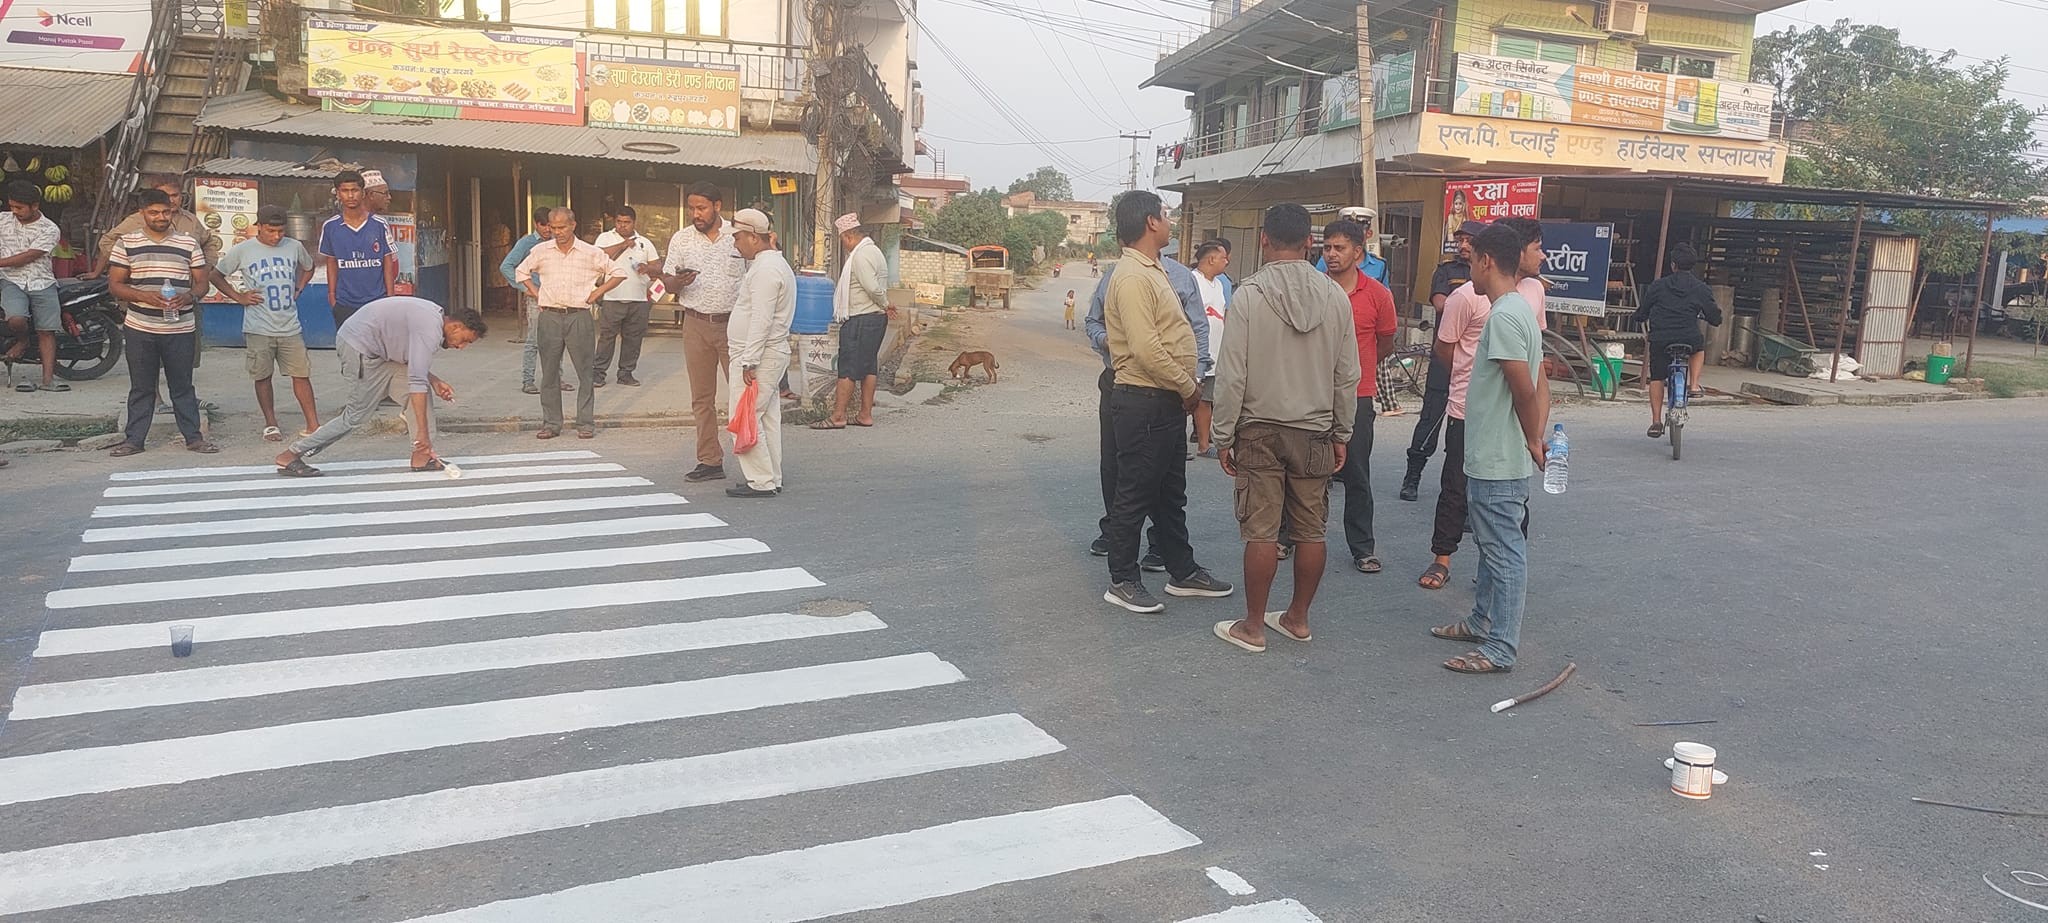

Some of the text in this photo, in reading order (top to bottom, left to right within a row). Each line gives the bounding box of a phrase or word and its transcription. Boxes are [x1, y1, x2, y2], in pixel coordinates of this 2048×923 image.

[57, 14, 92, 27] Ncell
[348, 39, 392, 58] चन्द्र
[1486, 59, 1512, 71] अटल
[631, 65, 663, 87] देउराली
[666, 68, 681, 88] डेरी
[684, 74, 702, 89] एण्ड
[1579, 71, 1611, 86] काशी
[1720, 101, 1740, 110] अटल
[1510, 127, 1559, 158] प्लाई
[1567, 133, 1607, 156] एण्ड
[1617, 135, 1690, 163] हार्डवेयर
[1698, 145, 1776, 168] सप्लायर्स
[1473, 183, 1509, 201] रक्षा
[1473, 205, 1488, 220] सुन
[1511, 204, 1535, 217] पसल
[352, 251, 365, 259] Fly
[1546, 243, 1589, 272] स्टील
[338, 258, 382, 269] Emirates
[267, 284, 292, 311] 83
